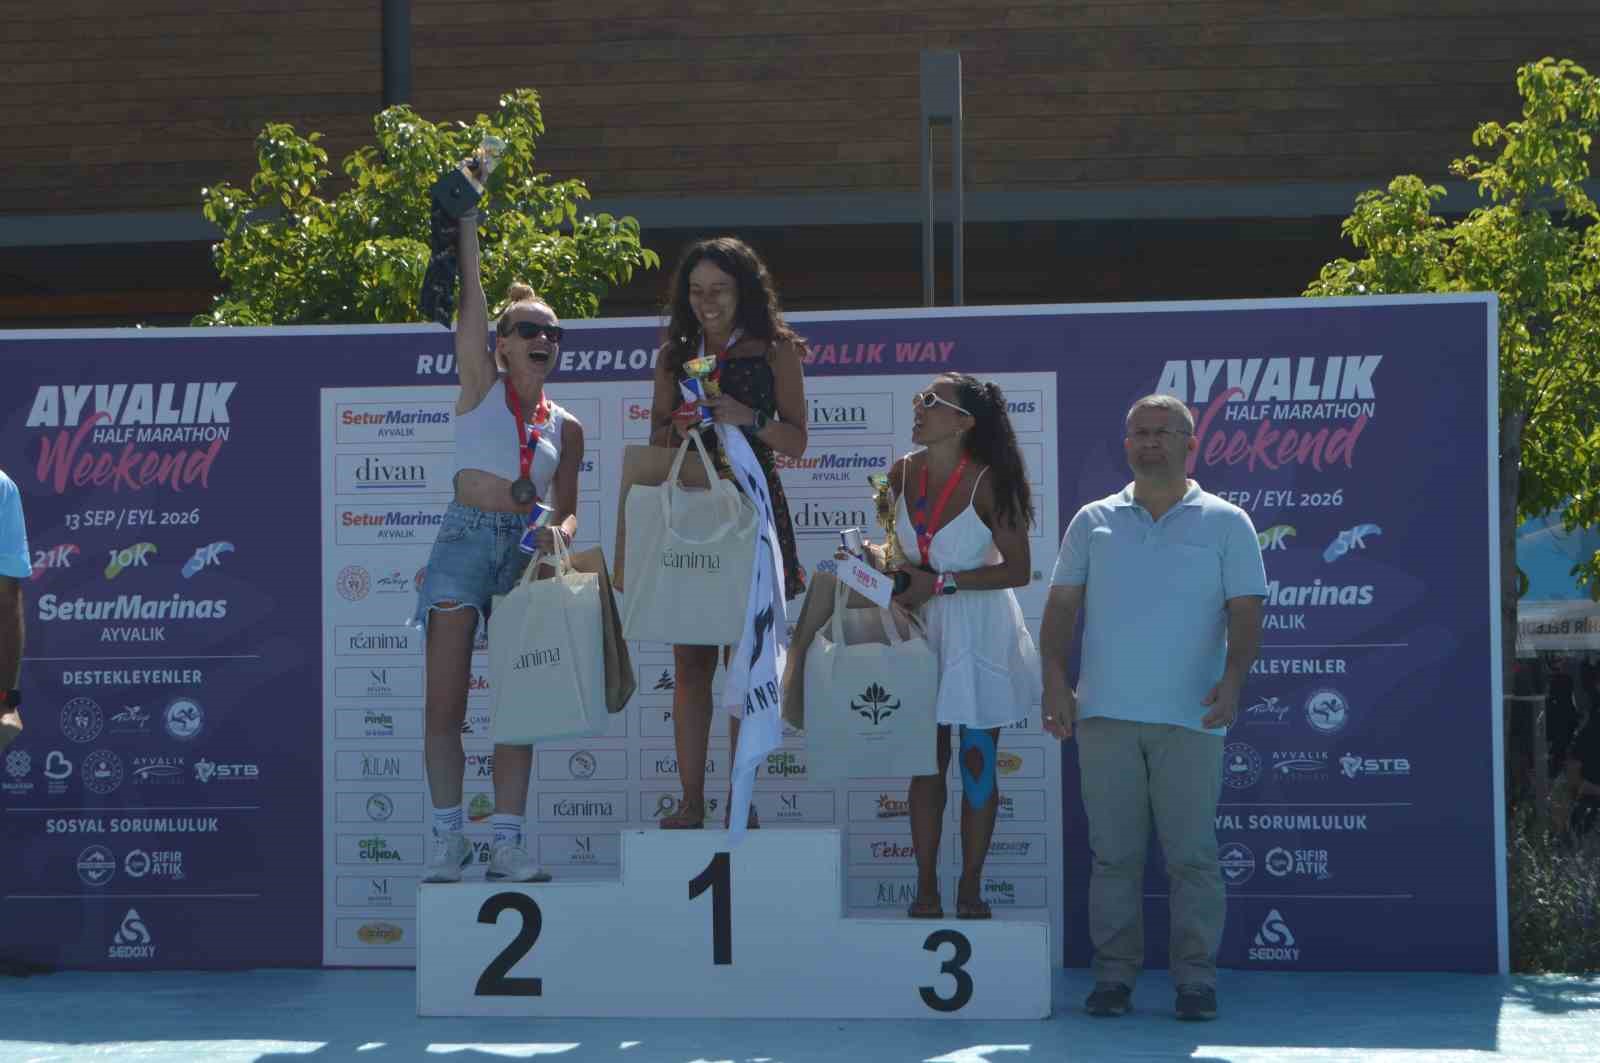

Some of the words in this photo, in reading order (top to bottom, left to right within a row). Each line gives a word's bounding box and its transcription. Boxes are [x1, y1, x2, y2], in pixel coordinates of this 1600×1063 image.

[895, 341, 956, 364] WAY
[416, 354, 458, 374] RU
[1154, 355, 1383, 403] AYVALIK
[25, 382, 238, 427] AYVALIK
[806, 400, 867, 424] ivan
[1225, 405, 1268, 421] HALF
[1273, 403, 1375, 419] MARATHON
[342, 409, 450, 425] SeturMarinas
[93, 428, 133, 443] HALF
[136, 427, 230, 442] MARATHON
[378, 428, 415, 437] AYVALIK
[36, 411, 223, 494] Weekend
[355, 457, 425, 481] divan
[813, 472, 851, 480] AYVALIK
[1300, 489, 1344, 506] 2026
[65, 513, 80, 530] 13
[160, 508, 200, 525] 2026
[342, 511, 446, 526] SeturMarina
[794, 503, 868, 527] divan
[378, 529, 415, 538] AYVALIK
[1336, 527, 1366, 555] 5K
[34, 547, 72, 568] 21K
[109, 546, 149, 567] 10K
[195, 546, 222, 570] 5K
[38, 593, 227, 620] SeturMarinas
[100, 627, 165, 641] AYVALIK
[63, 670, 202, 685] DESTEKLEYENLER
[46, 819, 105, 833] SOSYAL
[110, 818, 218, 832] SORUMLULUK
[1249, 815, 1367, 830] SORUMLULUK
[689, 852, 732, 966] 1
[109, 946, 155, 958] SEDOXY
[475, 892, 542, 996] 2
[1249, 948, 1300, 961] SEDOXY
[918, 929, 974, 1013] 3
